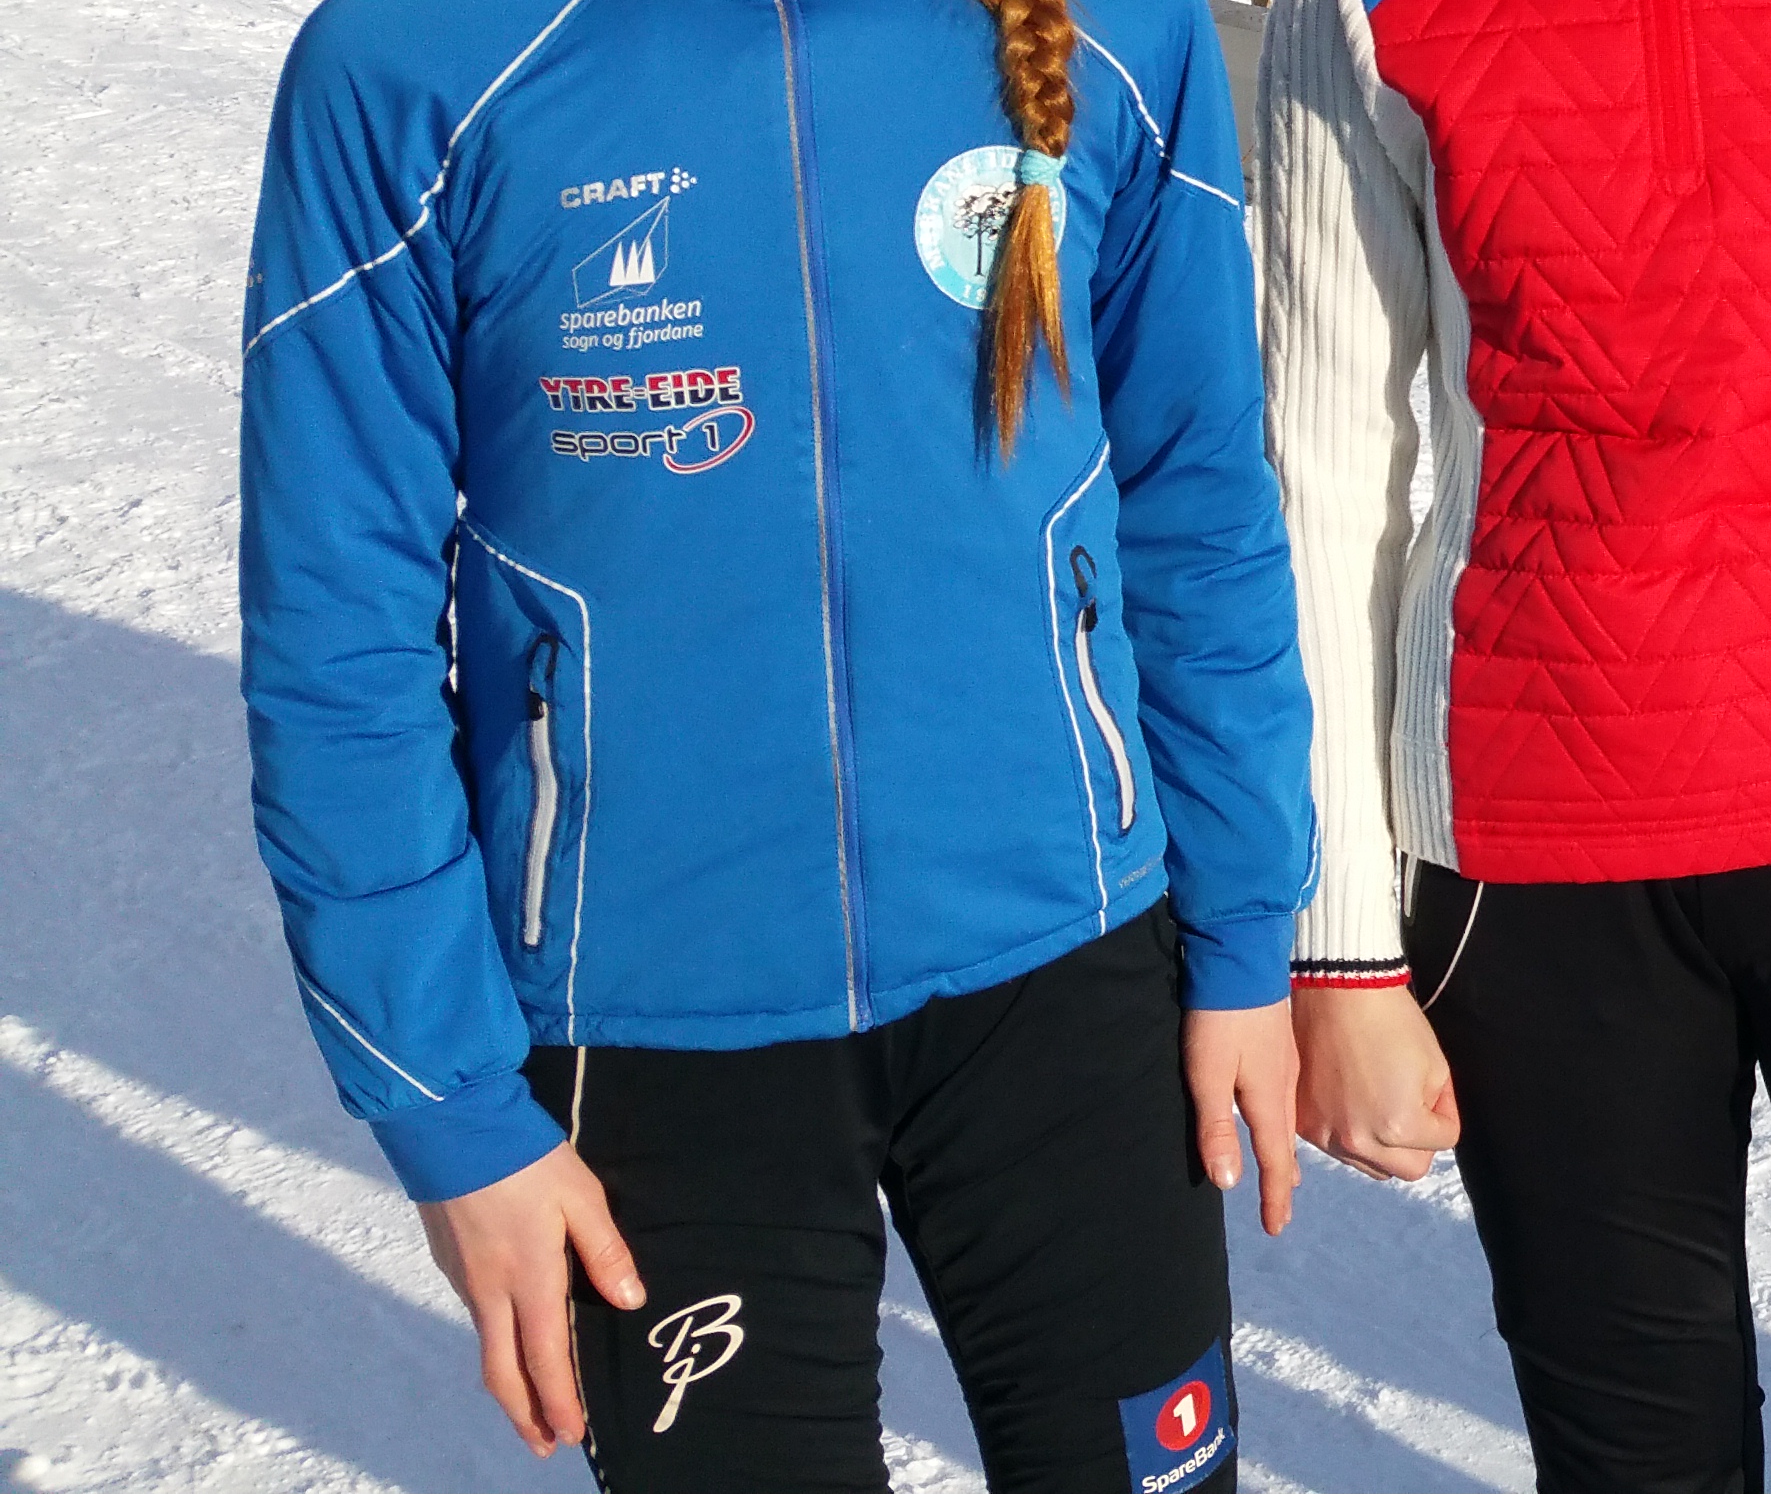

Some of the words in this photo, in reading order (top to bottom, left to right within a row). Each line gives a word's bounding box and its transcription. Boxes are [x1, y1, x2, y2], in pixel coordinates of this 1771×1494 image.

[561, 172, 666, 209] CRAFT
[560, 298, 702, 331] sparebanken
[562, 335, 599, 352] sogn
[602, 333, 623, 350] og
[627, 324, 704, 349] fjordane
[539, 366, 743, 412] YTRE-EIDE
[551, 425, 686, 462] sport
[702, 422, 720, 451] 1
[1142, 1427, 1226, 1494] SpareBank
